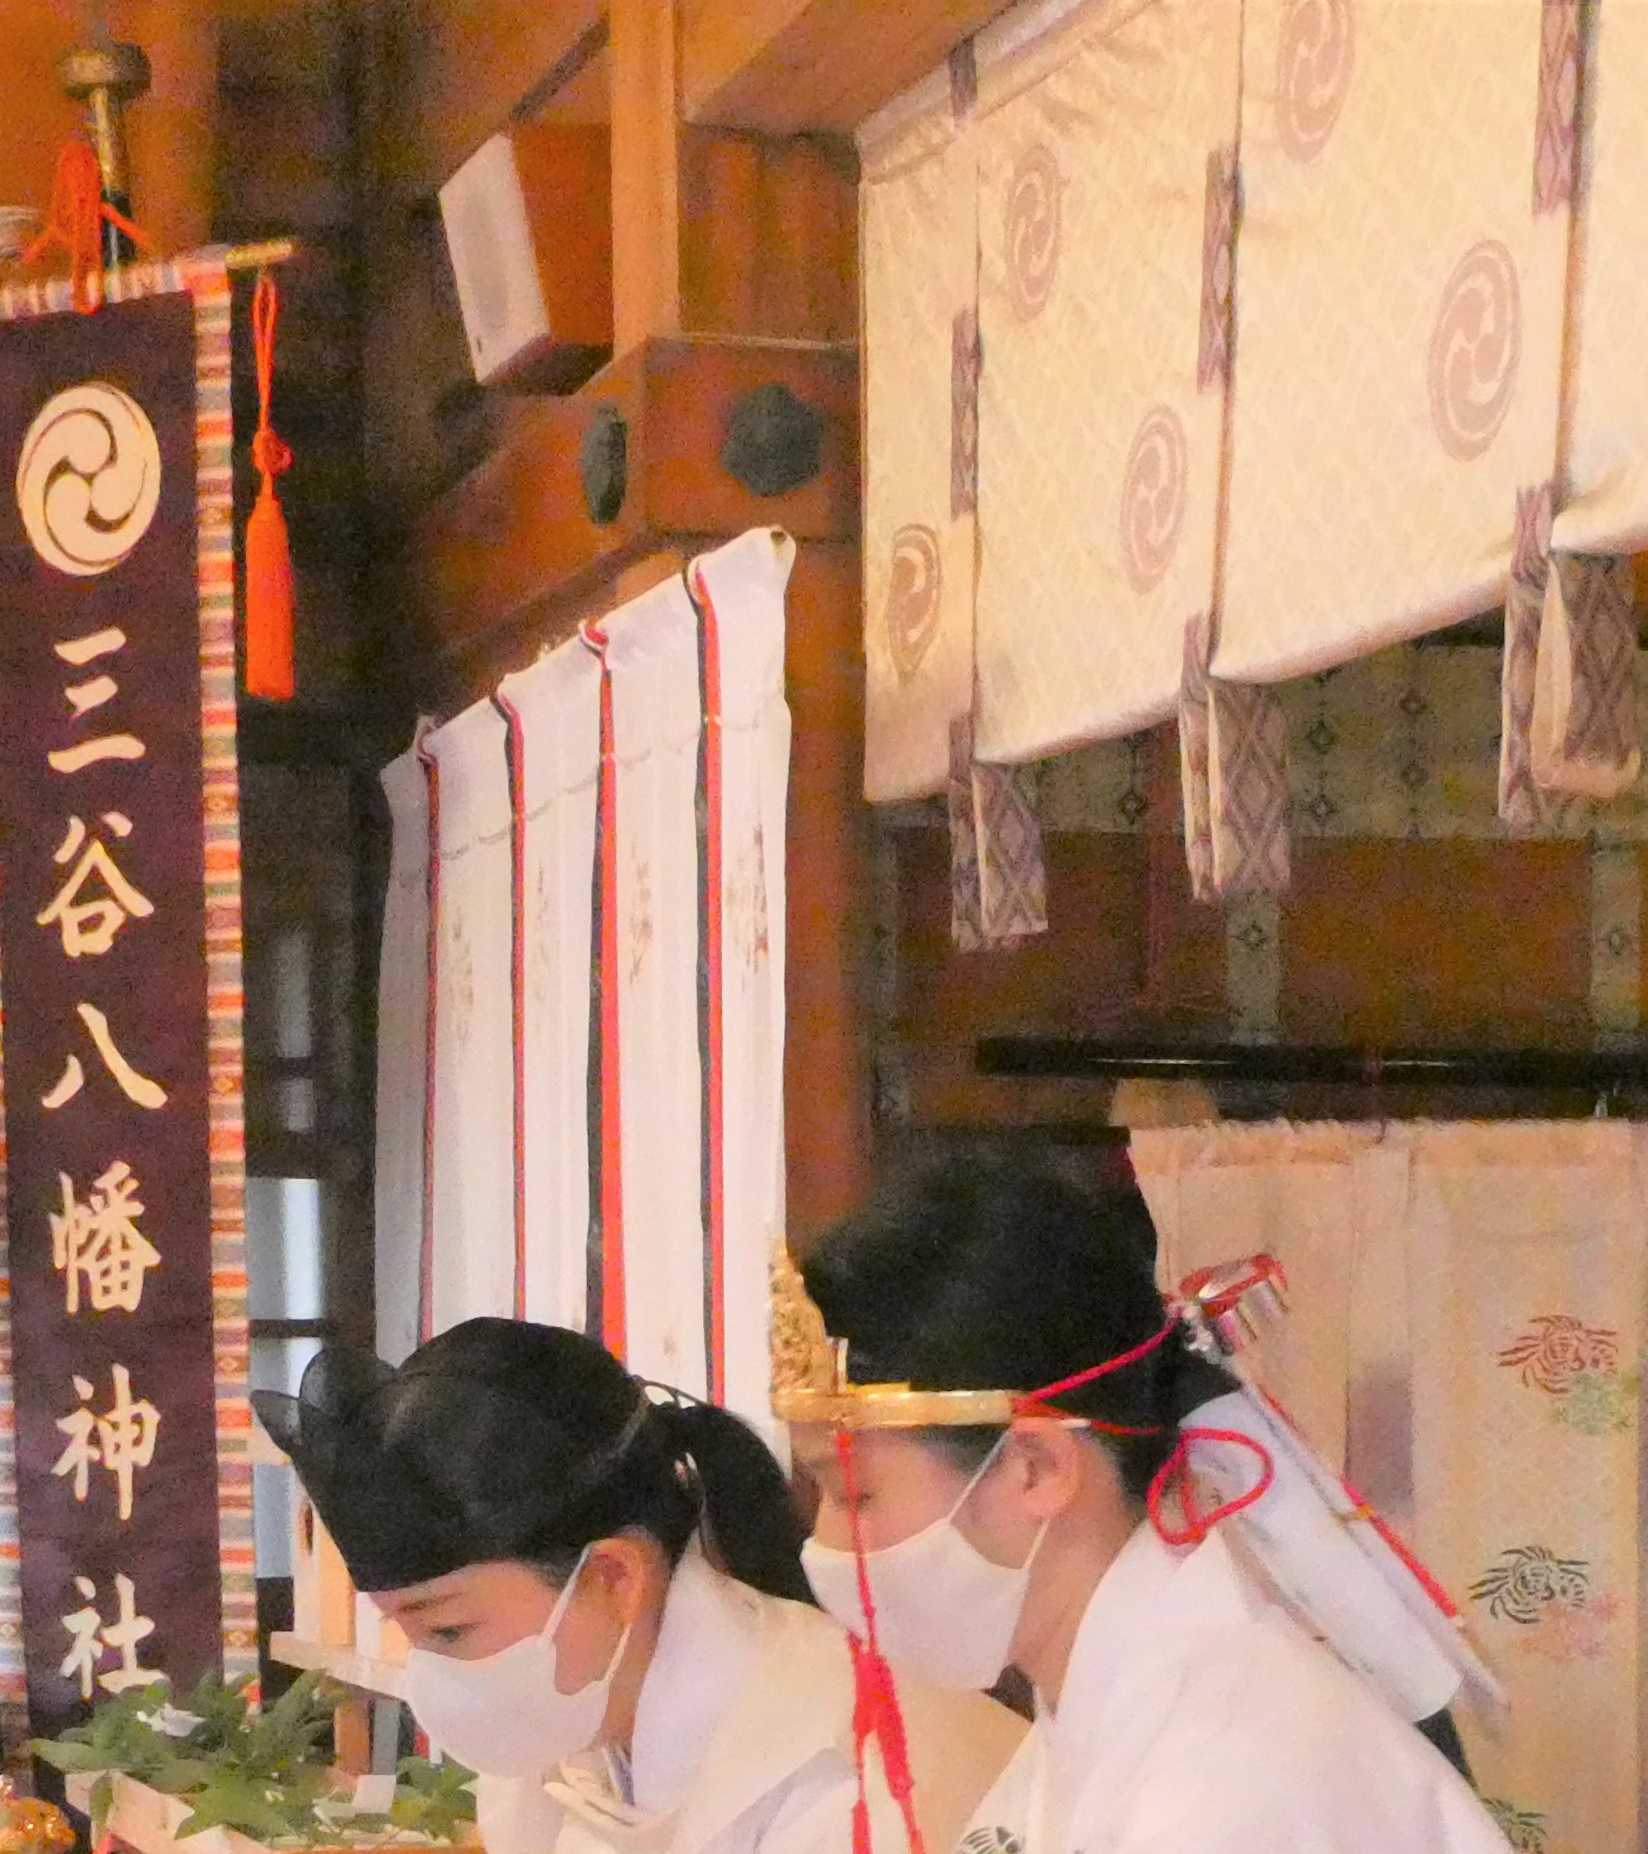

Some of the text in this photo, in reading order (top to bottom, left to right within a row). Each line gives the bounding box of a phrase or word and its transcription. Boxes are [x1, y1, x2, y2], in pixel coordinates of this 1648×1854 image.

[37, 626, 168, 1700] 三谷八幡神社
